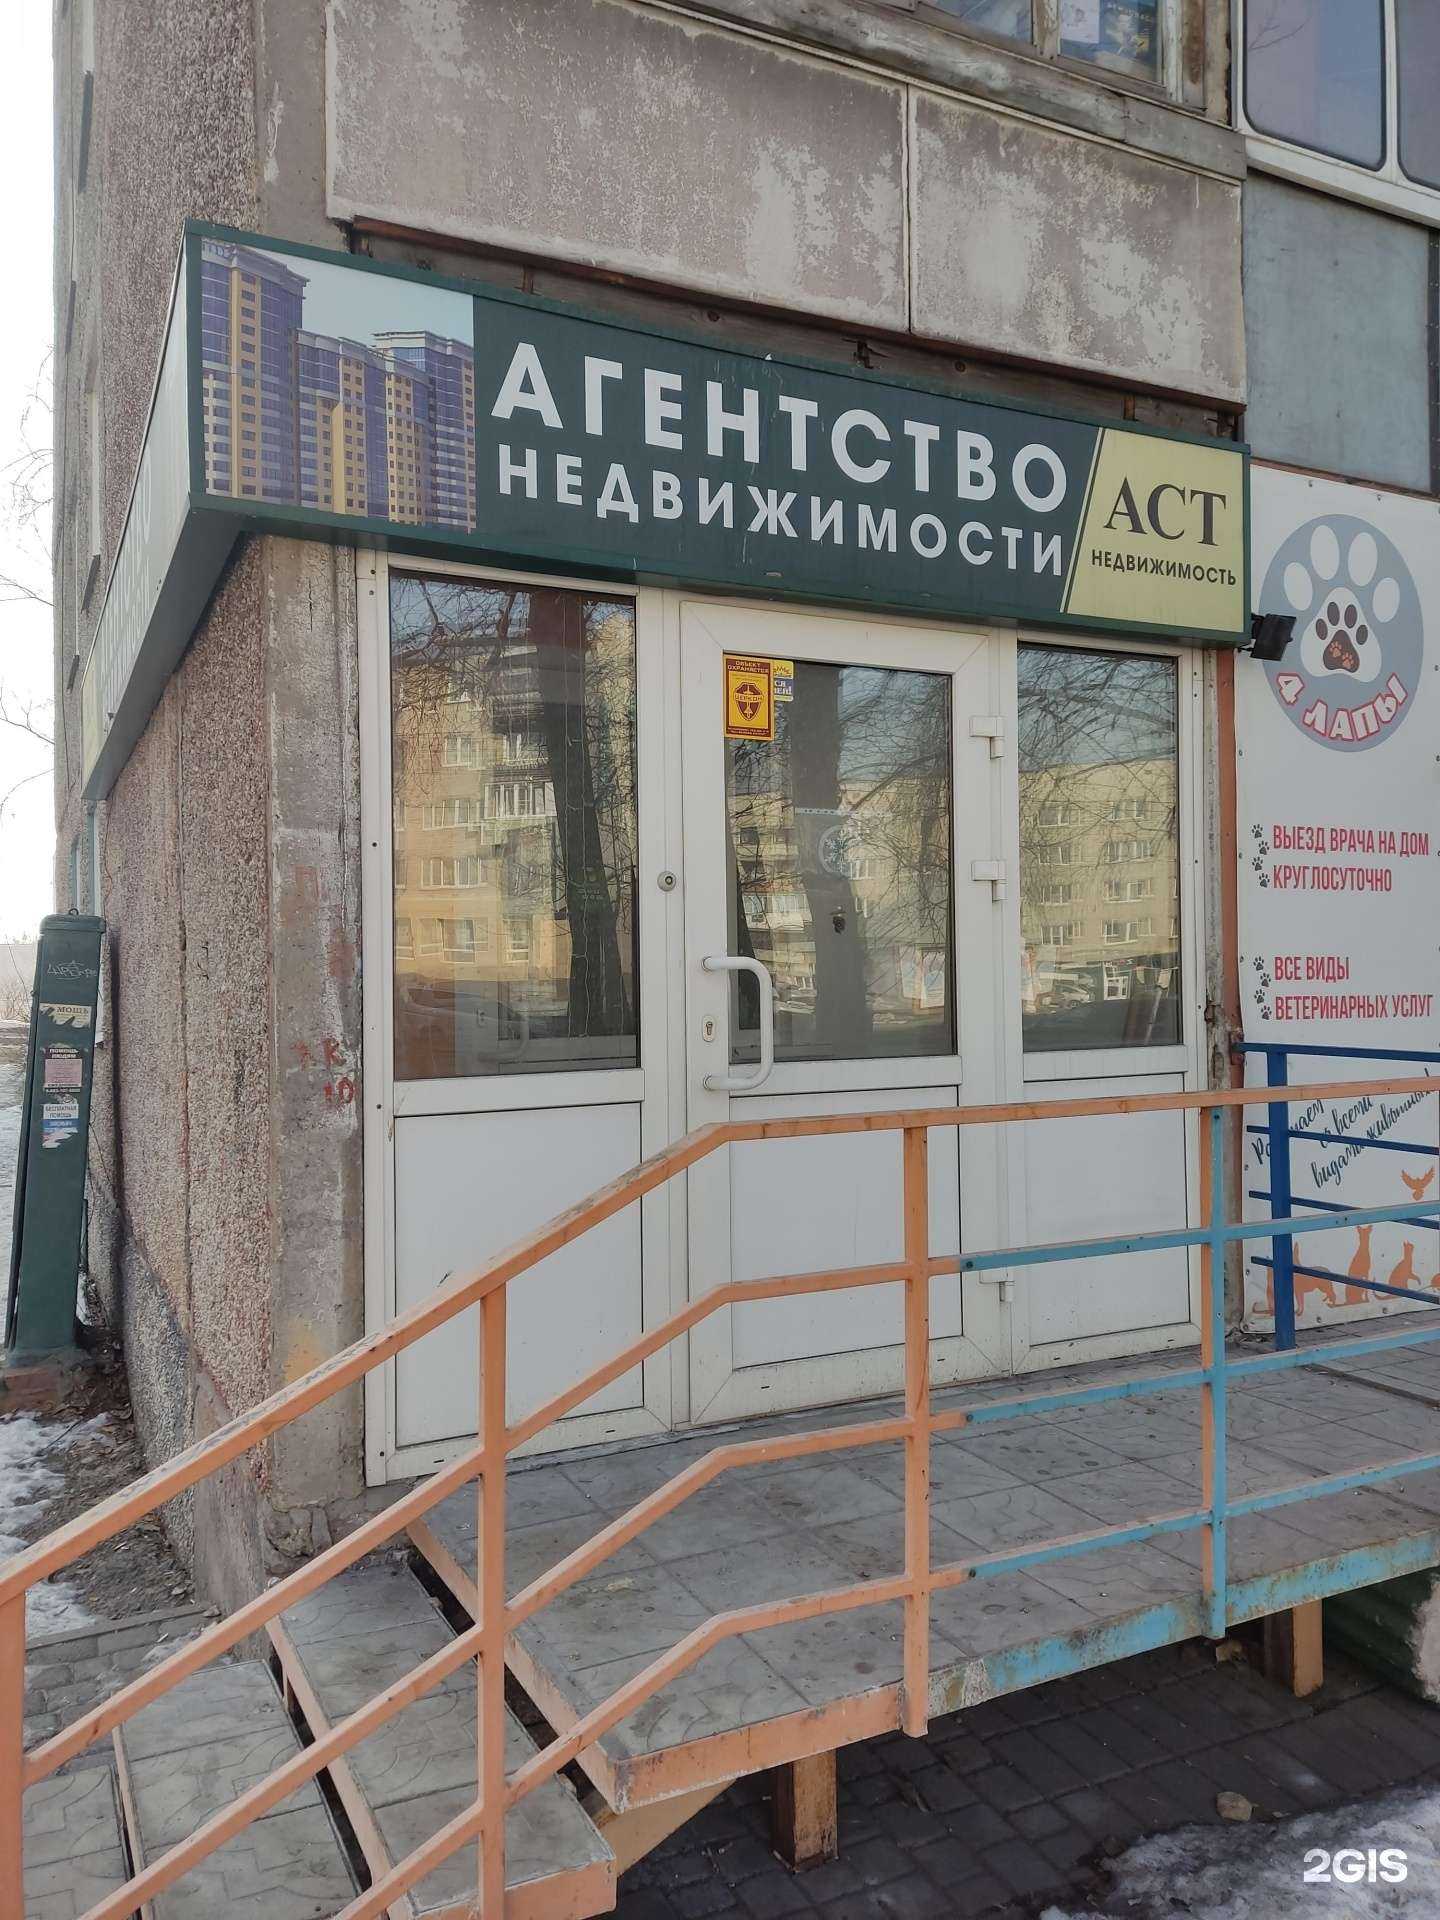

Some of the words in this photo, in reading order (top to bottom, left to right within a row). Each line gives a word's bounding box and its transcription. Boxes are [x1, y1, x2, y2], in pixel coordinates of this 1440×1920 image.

[491, 342, 1067, 512] АГЕНТСТВО
[498, 443, 1063, 577] НЕДВИЖИМОСТИ
[1103, 476, 1227, 547] АСТ
[1091, 549, 1236, 586] НЕДВИЖИМОСТЬ
[1275, 672, 1306, 705] 4
[1302, 672, 1408, 742] ЛАПЫ
[1273, 825, 1325, 853] ВЫЕЗД
[1330, 828, 1375, 853] ВРАЧА
[1378, 831, 1397, 854] НА
[1400, 832, 1429, 857] ДОМ
[1273, 865, 1393, 892] КРУГЛОСУТОЧНО
[1274, 956, 1302, 981] ВСЕ
[1306, 956, 1350, 983] ВИДЫ
[1275, 994, 1388, 1020] ВЕТЕРИНАРНЫХ
[1392, 994, 1434, 1018] УСЛУГ
